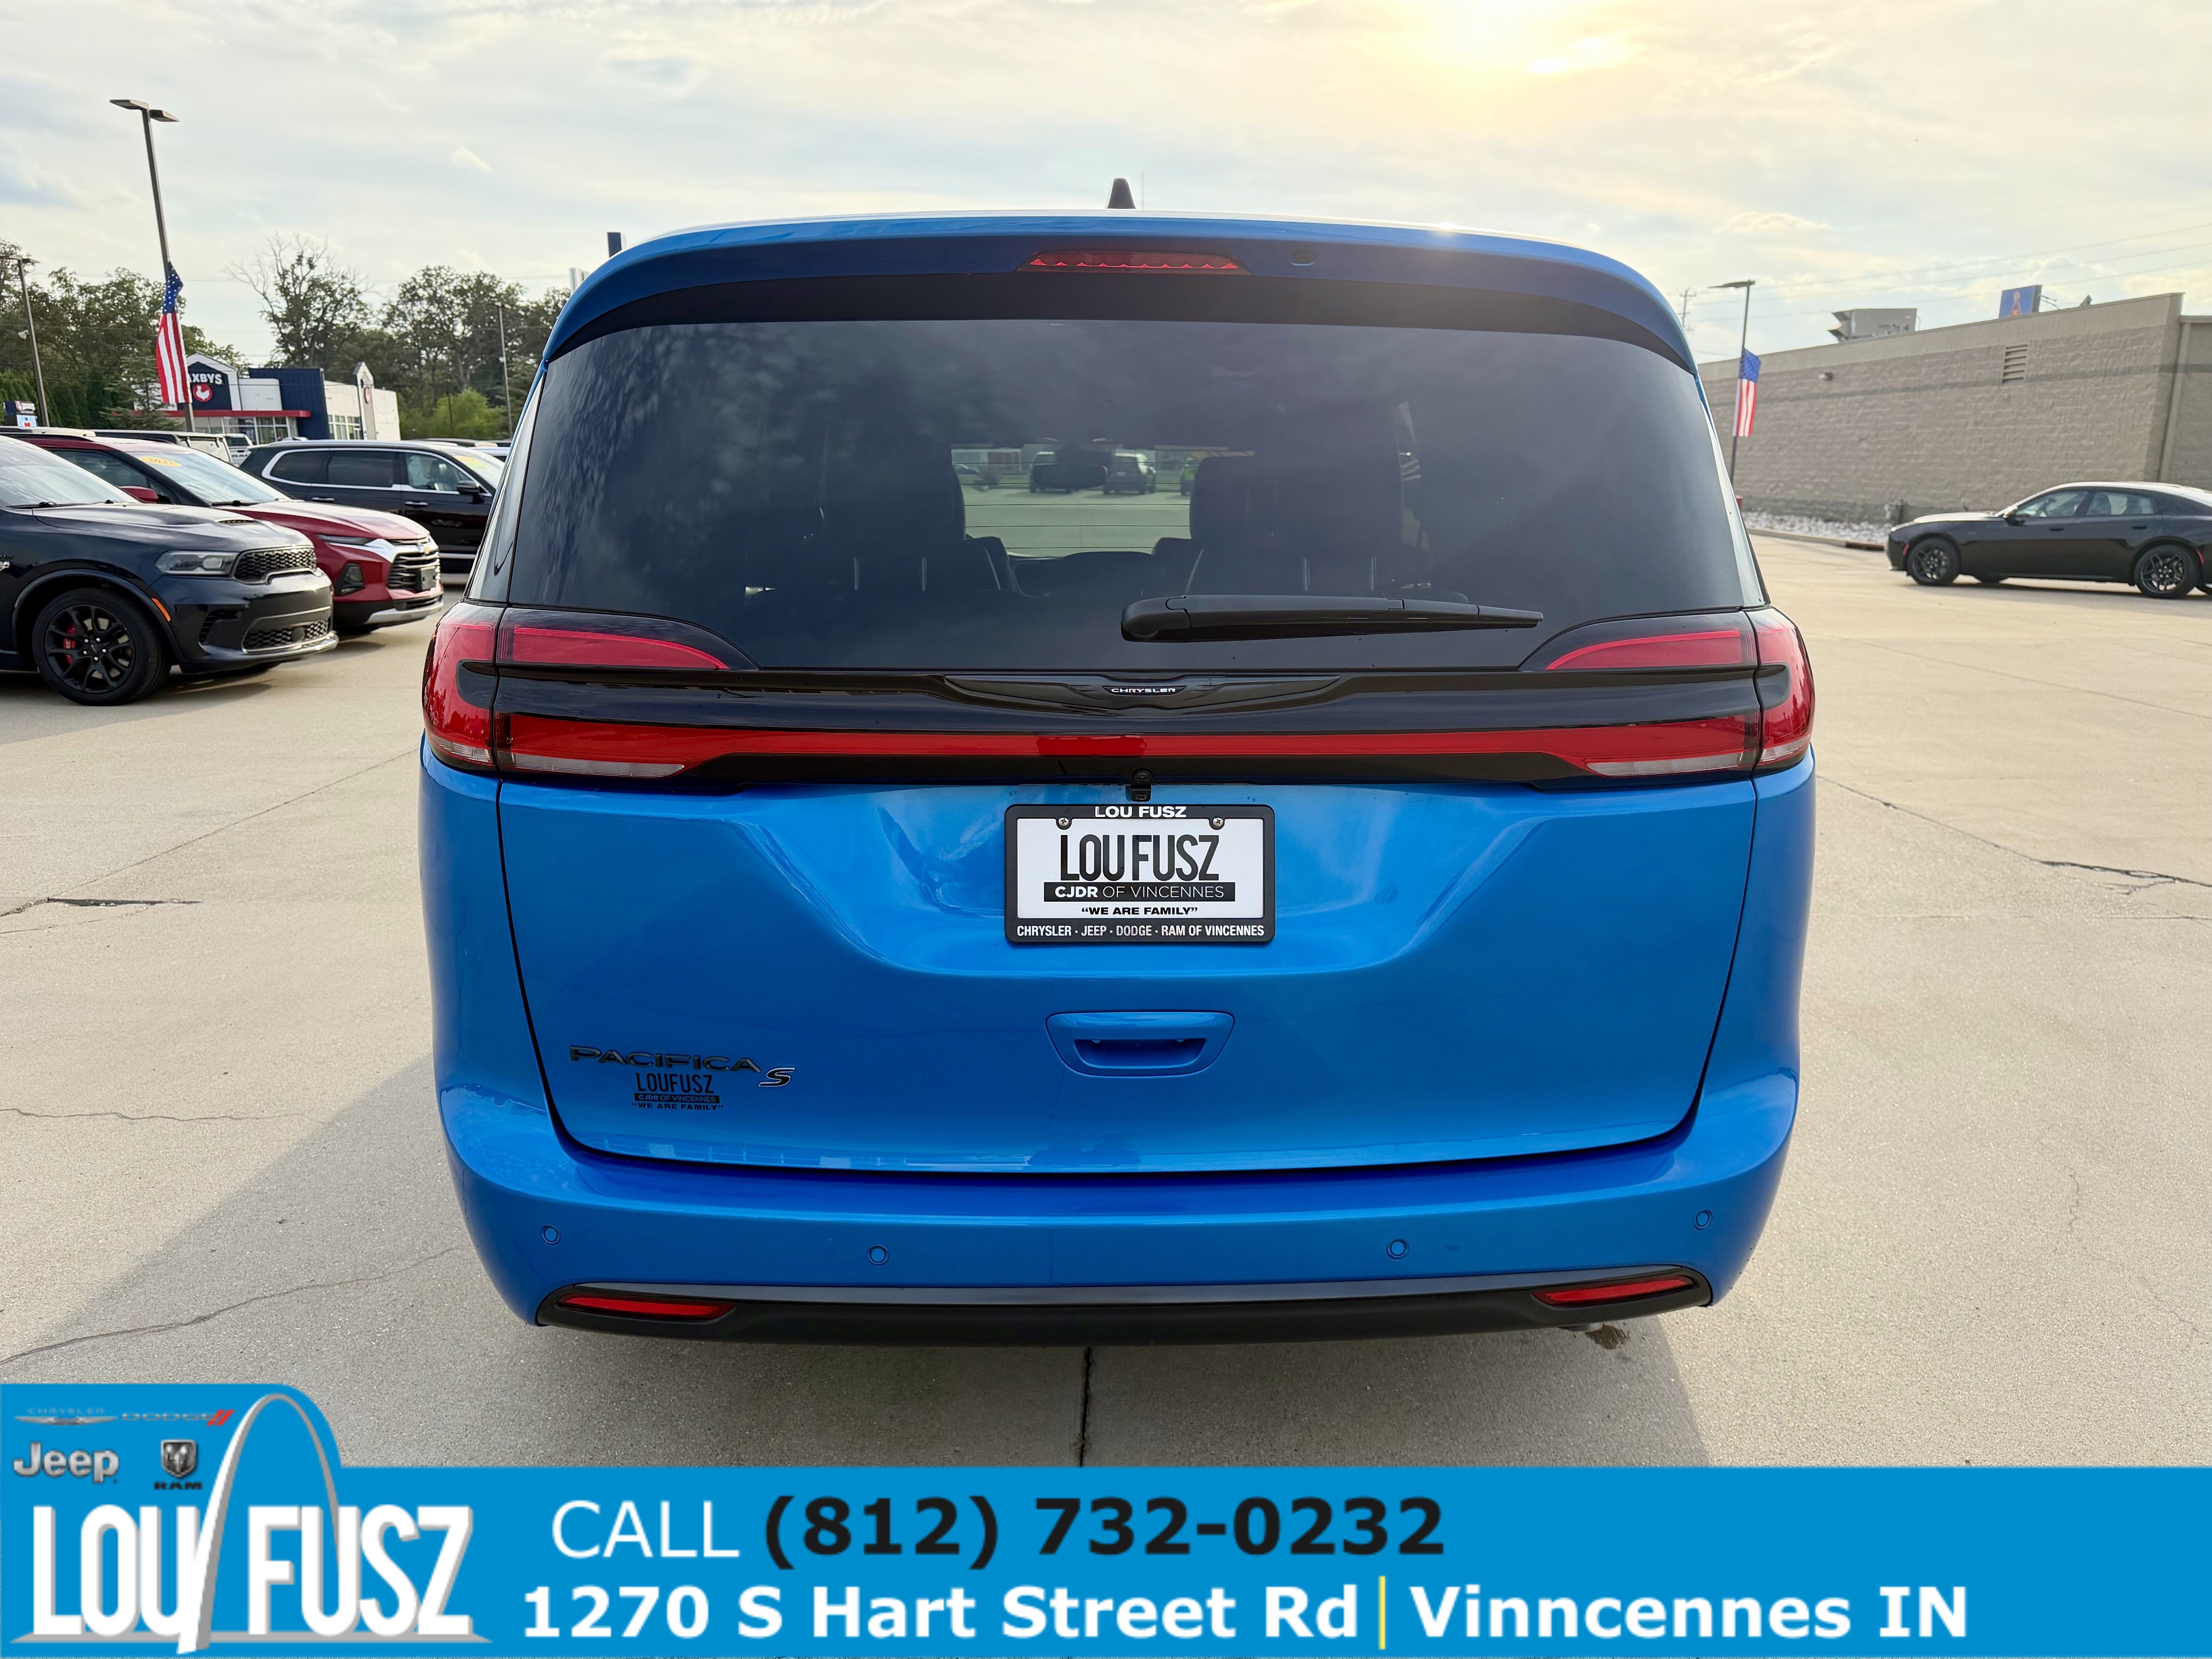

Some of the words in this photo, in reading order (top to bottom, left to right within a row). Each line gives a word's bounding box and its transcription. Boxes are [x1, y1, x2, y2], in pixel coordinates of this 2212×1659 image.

[1095, 806, 1132, 818] LOU
[1139, 806, 1187, 818] FUSZ
[1061, 835, 1125, 881] LOU
[1132, 835, 1219, 881] FUSZ
[1055, 886, 1098, 898] CJDR
[1103, 886, 1125, 898] OF
[1130, 886, 1224, 898] VINCENNES
[1081, 907, 1109, 915] “WE
[1113, 907, 1140, 915] ARE
[1144, 907, 1198, 915] FAMILY”
[1017, 926, 1072, 937] CHRYSLER
[1081, 926, 1107, 937] JEEP
[1116, 926, 1152, 937] DODGE
[1161, 926, 1186, 937] RAM
[1188, 926, 1203, 937] OF
[1206, 926, 1264, 937] VINCENNES
[570, 1045, 762, 1073] PACIFICA
[758, 1068, 795, 1087] S
